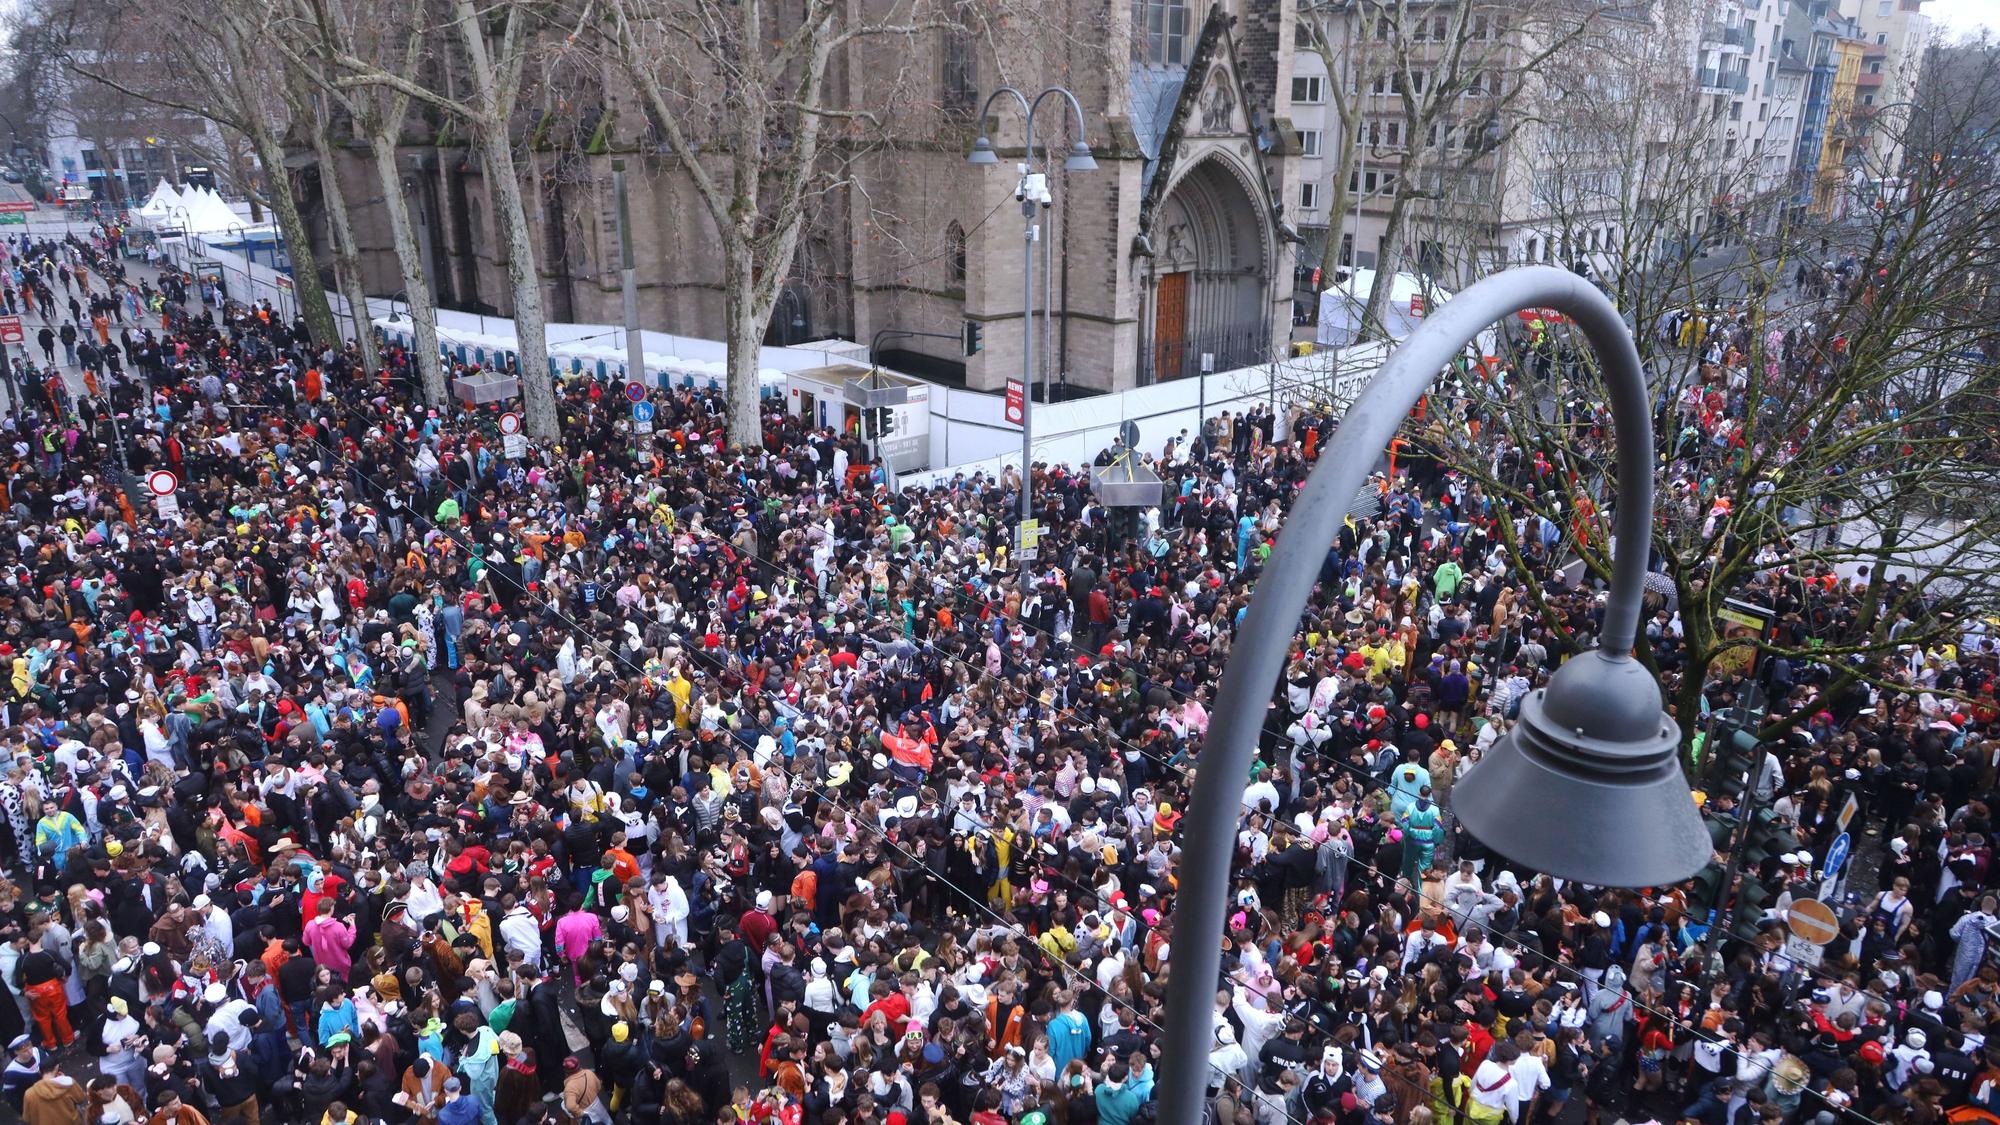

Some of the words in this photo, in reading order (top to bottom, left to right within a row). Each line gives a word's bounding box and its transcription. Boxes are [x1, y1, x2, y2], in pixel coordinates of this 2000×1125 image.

[1008, 381, 1023, 393] REWE
[584, 589, 595, 599] 12
[1942, 1067, 1967, 1080] FBI
